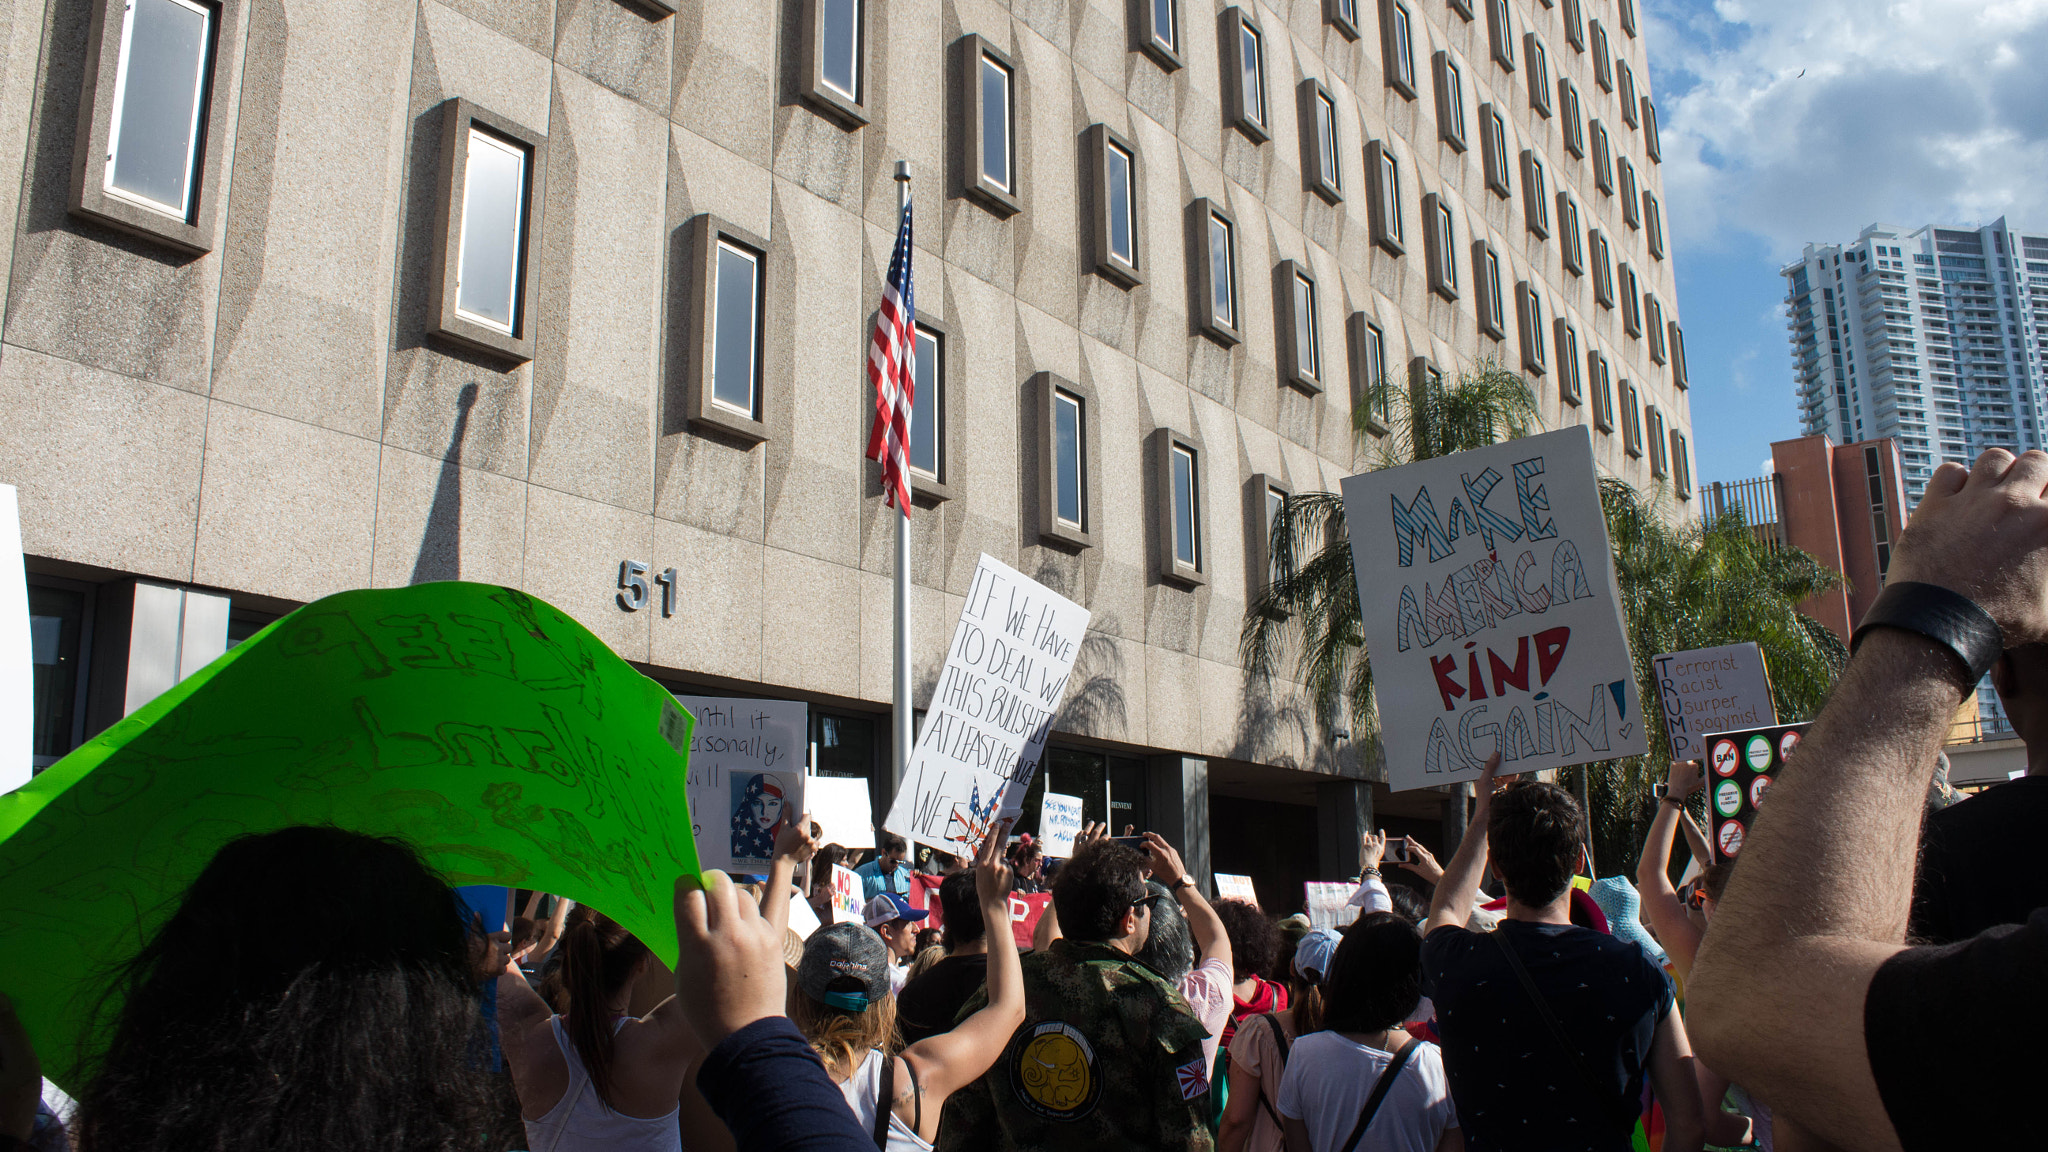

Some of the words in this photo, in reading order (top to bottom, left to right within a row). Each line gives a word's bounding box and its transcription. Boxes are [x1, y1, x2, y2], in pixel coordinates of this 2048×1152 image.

[1390, 456, 1558, 568] MAKE
[617, 560, 677, 616] 51
[965, 565, 1006, 620] IF
[1005, 586, 1031, 641] WE
[1032, 603, 1074, 663] HAVE
[1397, 539, 1595, 653] AMERICA
[959, 618, 985, 665] TO
[986, 638, 1031, 693] DEAL
[1039, 667, 1069, 707] W/
[1430, 626, 1571, 711] KIND
[1655, 653, 1739, 678] Terrorist
[1661, 674, 1723, 698] Racist
[751, 710, 770, 730] it
[942, 665, 987, 718] THIS
[985, 685, 1057, 745] BULLSHIT
[1424, 678, 1625, 773] AGAIN!
[1668, 704, 1761, 734] Misogynist
[923, 710, 959, 755] AT
[951, 721, 1000, 769] LEAST
[1716, 753, 1735, 763] BAN
[833, 892, 860, 915] HUMAN
[837, 870, 850, 896] NO
[829, 960, 868, 972] Dolphins
